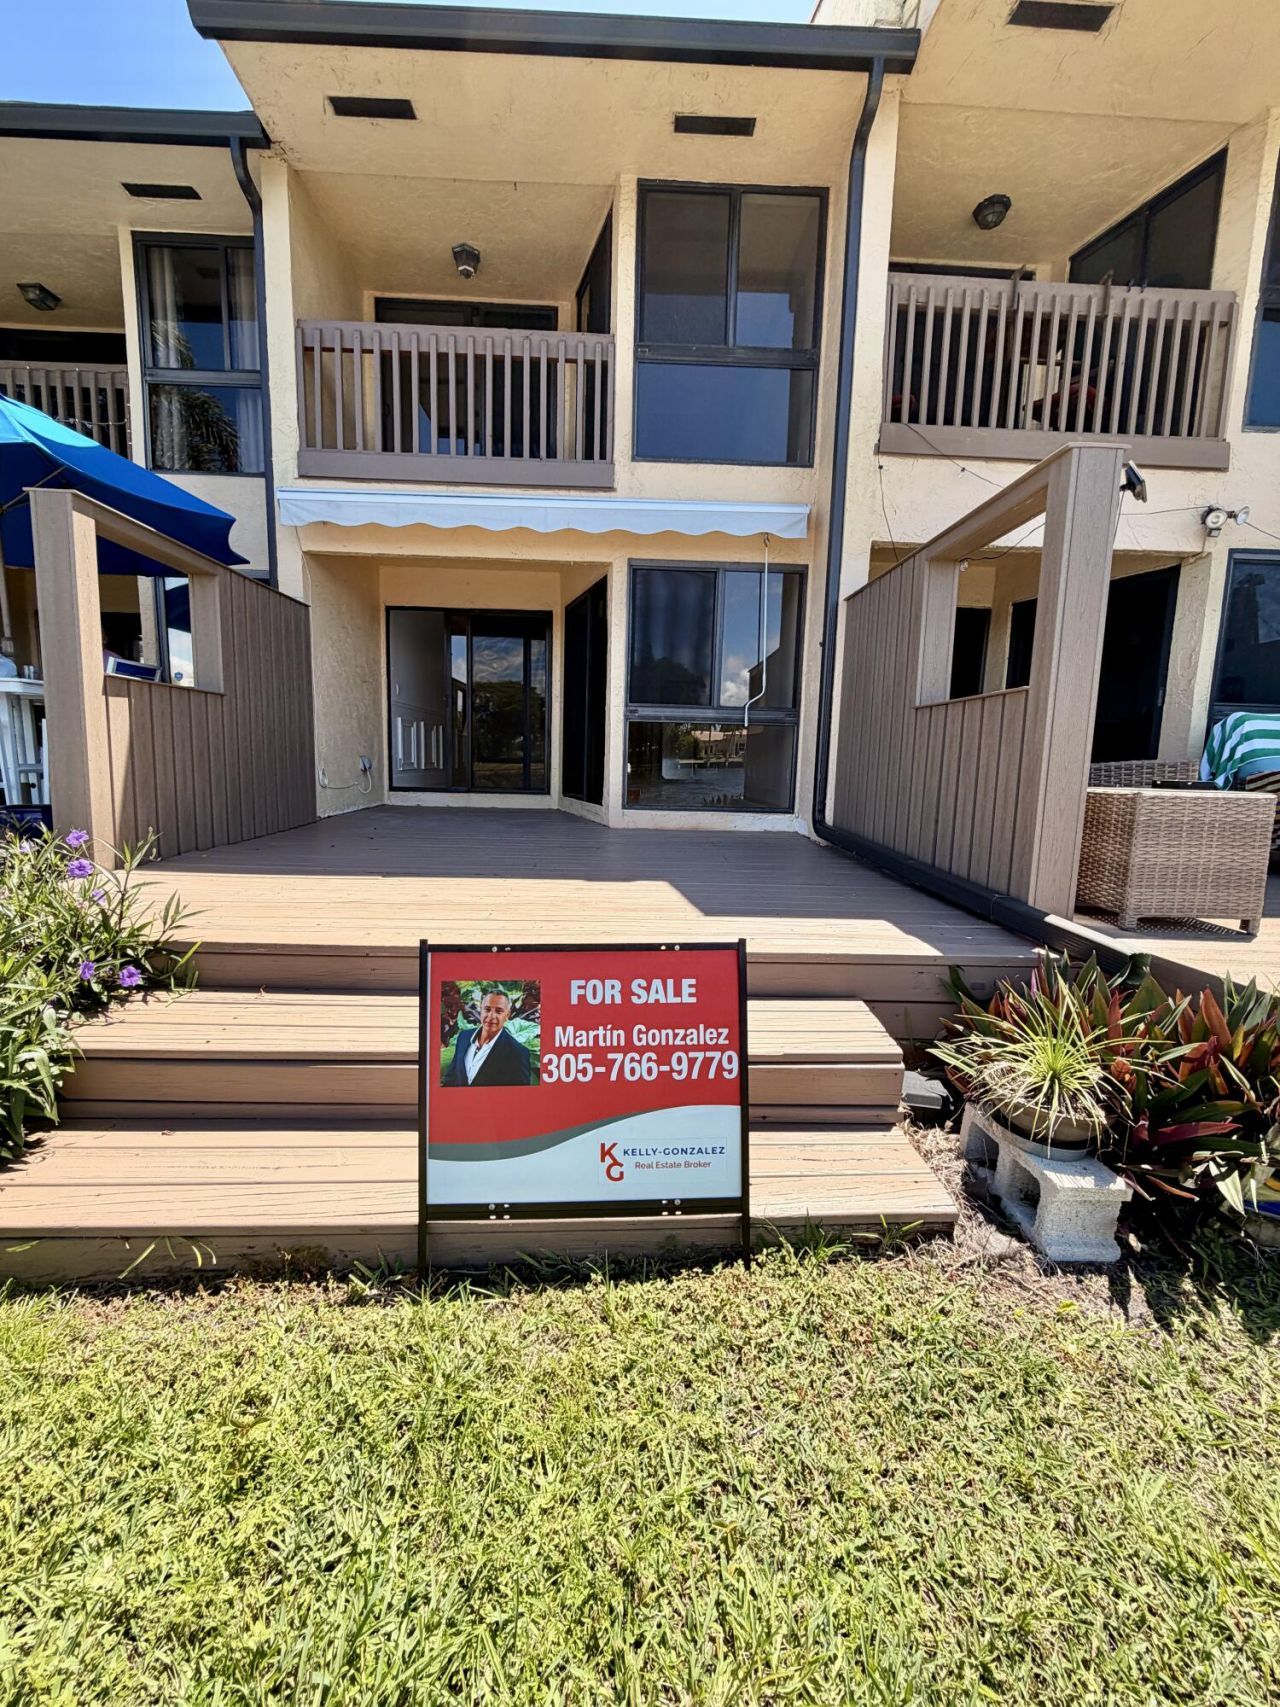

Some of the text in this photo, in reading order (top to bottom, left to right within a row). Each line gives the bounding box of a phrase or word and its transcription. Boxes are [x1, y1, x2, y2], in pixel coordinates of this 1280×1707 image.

[570, 978, 697, 1005] FOR SALE
[554, 1024, 729, 1047] Martín Gonzalez
[542, 1050, 739, 1083] 305-766-9779
[623, 1146, 726, 1156] KELLY-GONZALEZ
[635, 1160, 711, 1169] Real Estate Broker
